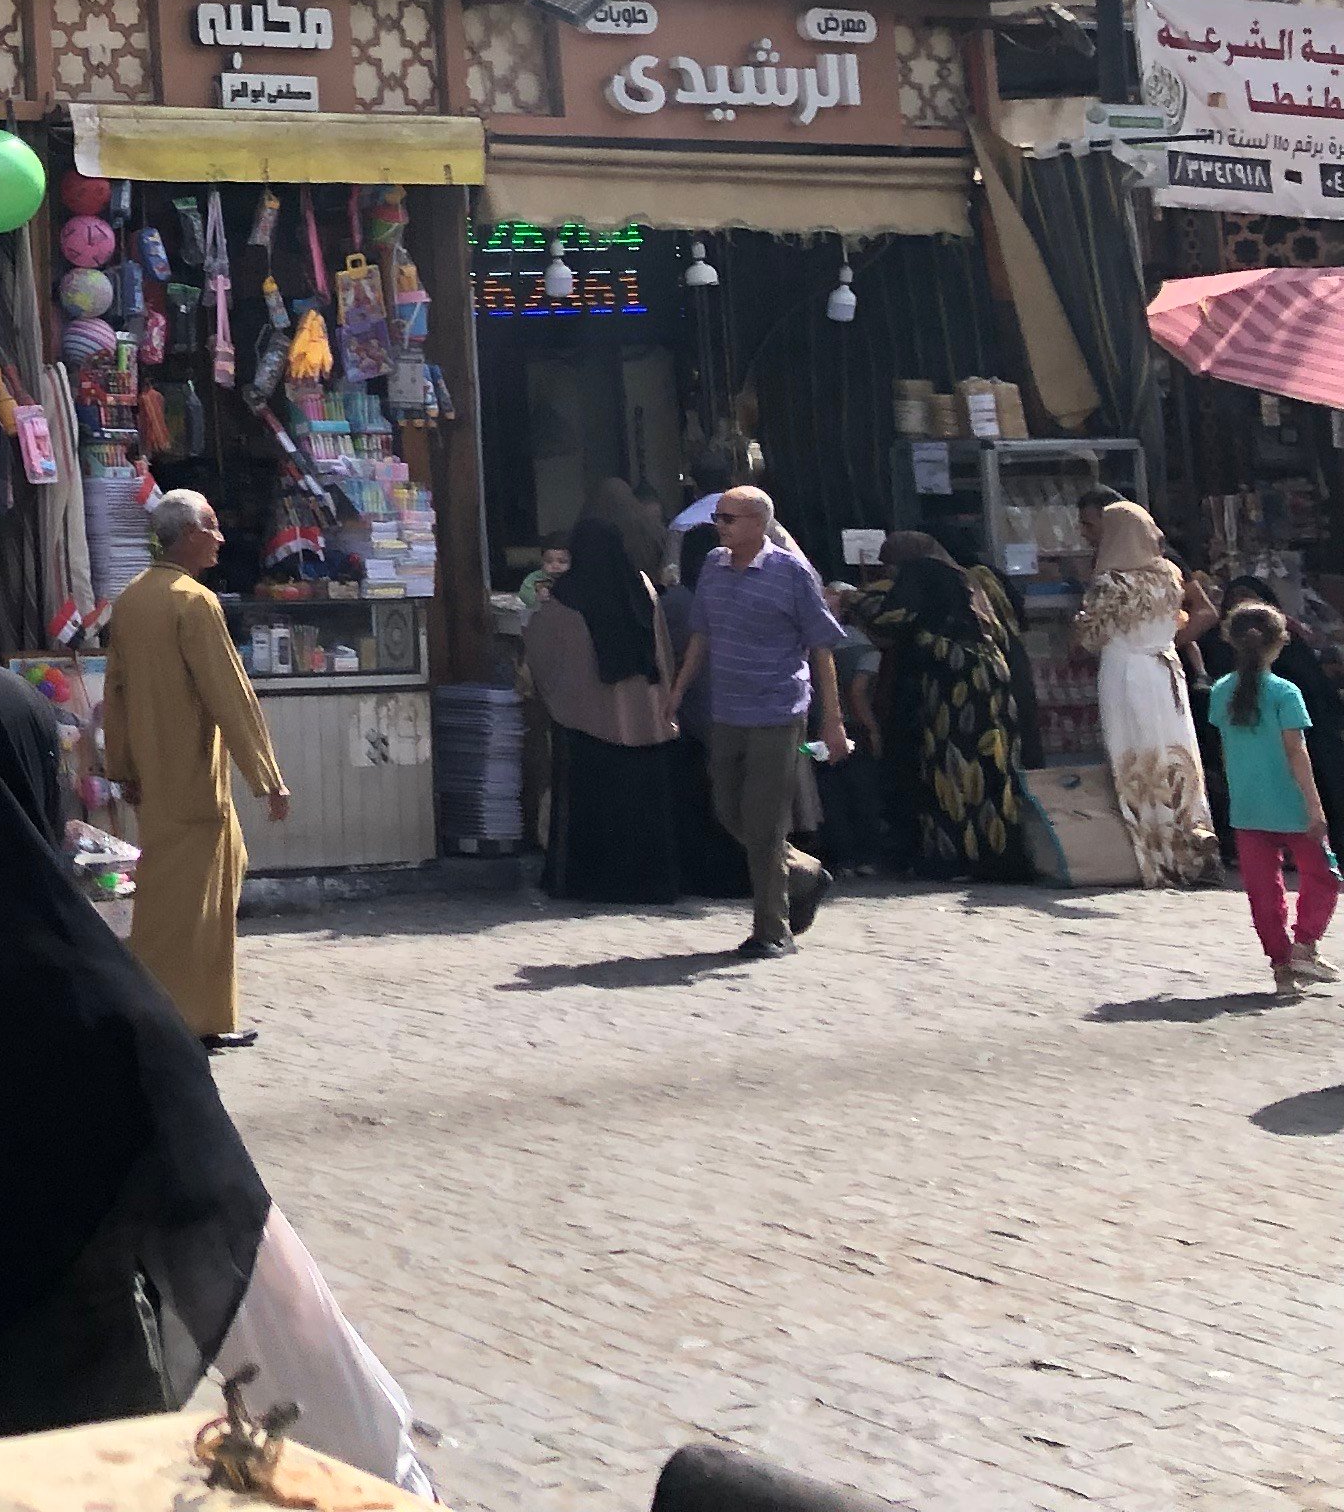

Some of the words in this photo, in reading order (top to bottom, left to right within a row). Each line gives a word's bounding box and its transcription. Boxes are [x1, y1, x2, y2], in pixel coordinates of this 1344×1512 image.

[817, 12, 867, 37] معرض
[1157, 18, 1295, 67] الشرعية
[608, 37, 862, 126] الرشيدى
[1227, 128, 1270, 150] لسنة
